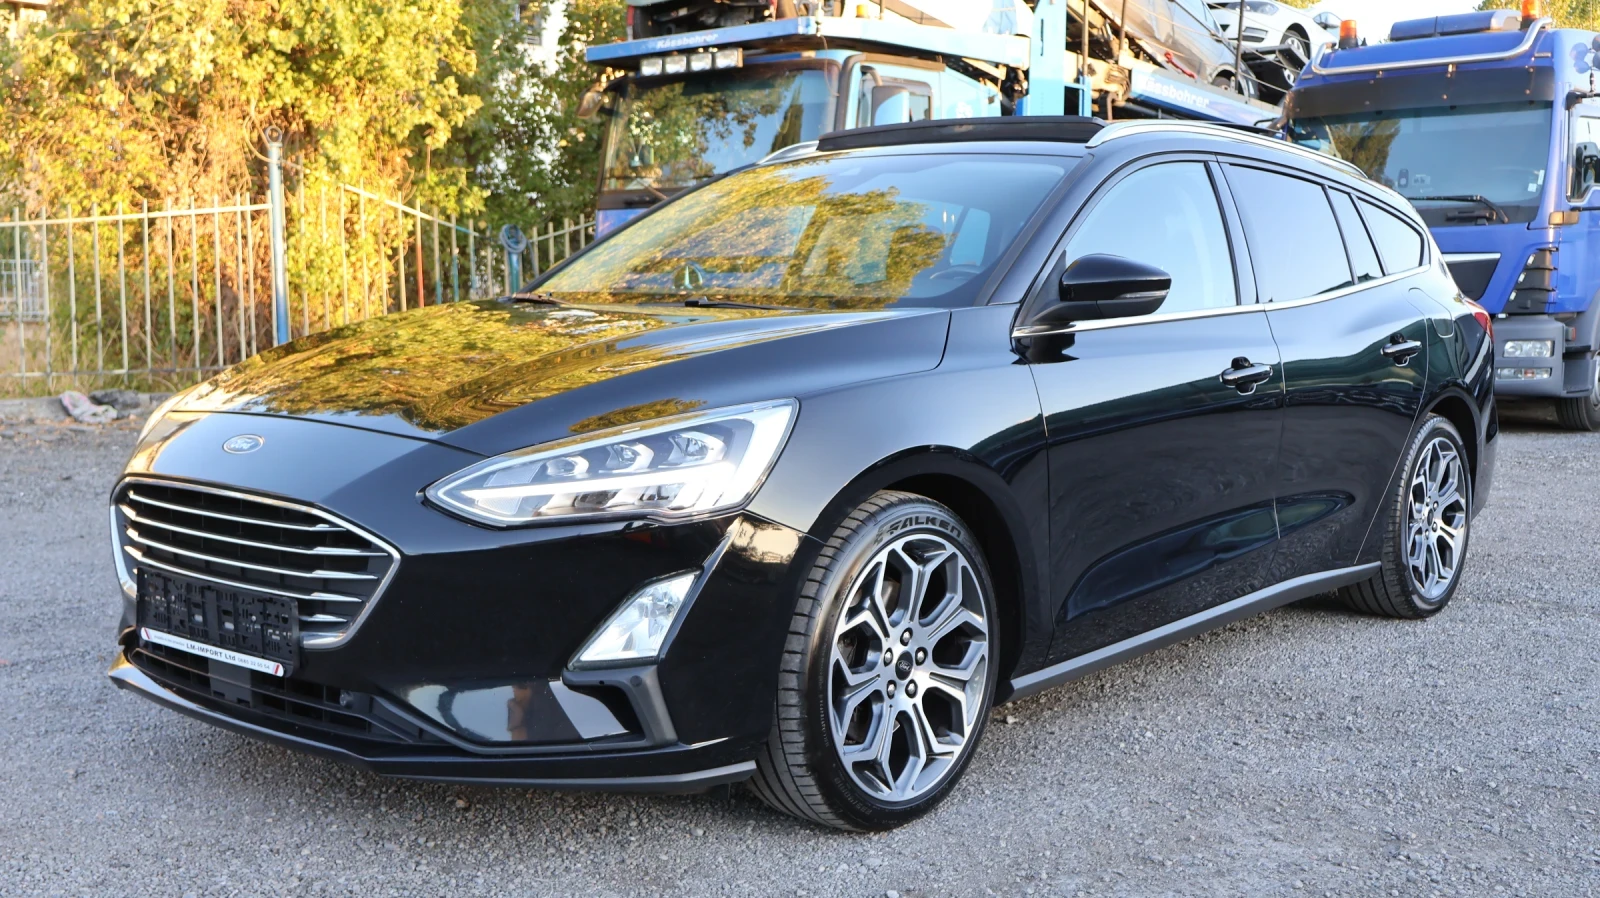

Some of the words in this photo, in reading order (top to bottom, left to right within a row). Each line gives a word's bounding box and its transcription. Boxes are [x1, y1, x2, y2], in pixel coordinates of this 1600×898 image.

[226, 437, 259, 450] Ford
[187, 643, 223, 658] LM-IMPORT
[224, 653, 235, 661] Ltd
